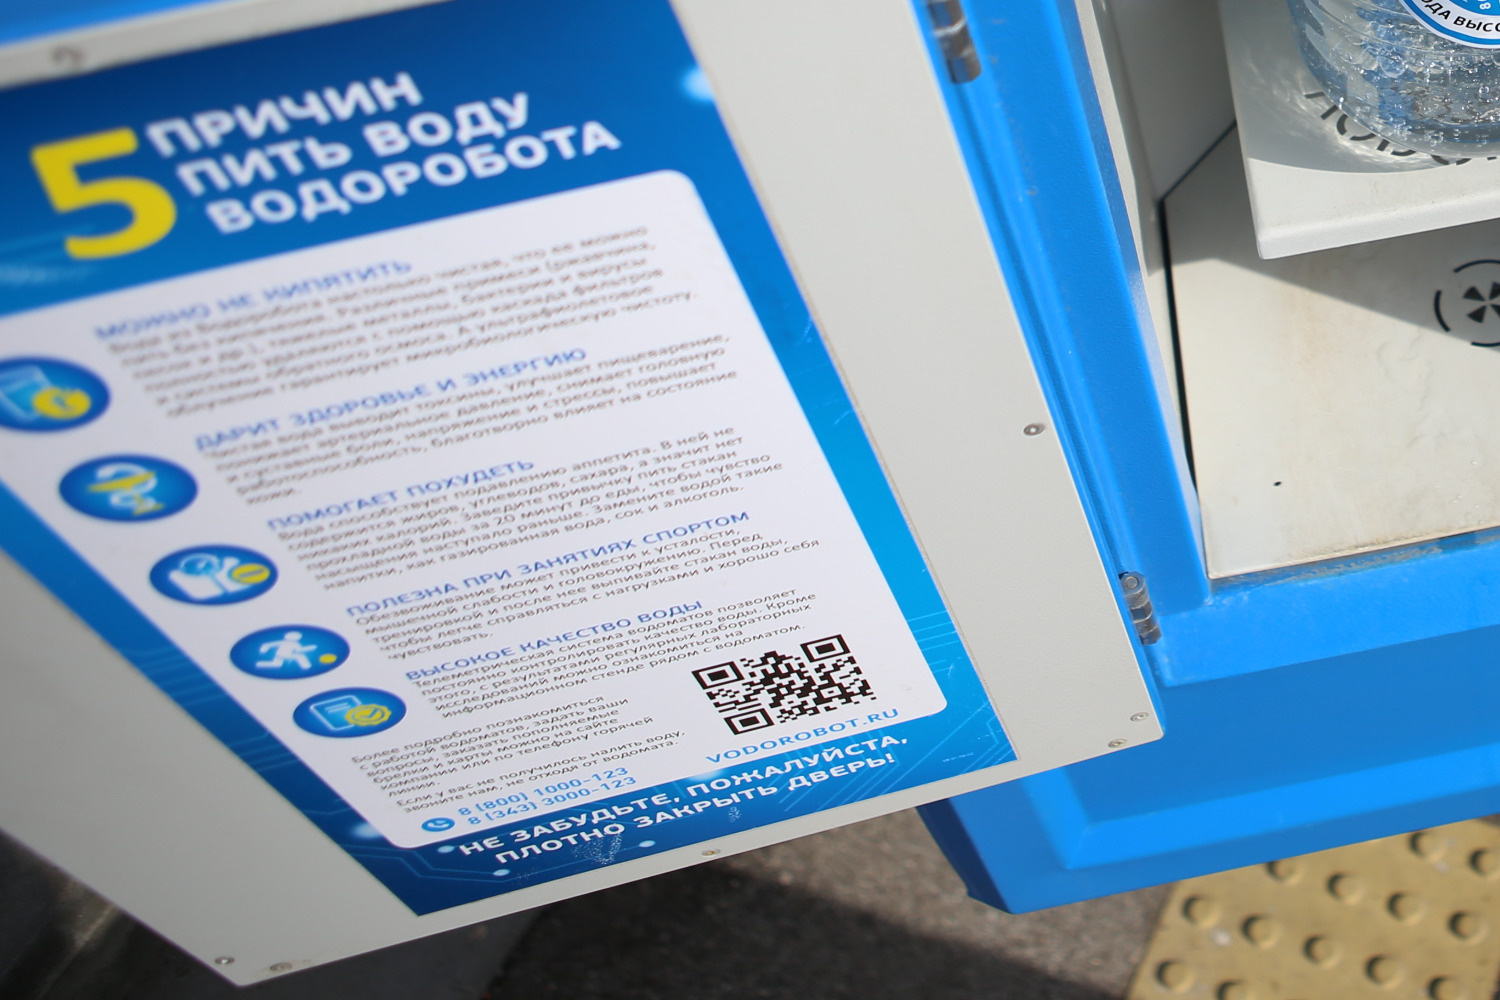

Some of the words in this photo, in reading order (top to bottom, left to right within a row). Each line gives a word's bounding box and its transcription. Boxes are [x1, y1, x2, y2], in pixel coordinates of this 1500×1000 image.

[146, 72, 423, 158] ПРИЧИН
[176, 136, 352, 197] ПИТЬ
[363, 93, 529, 157] ВОДУ
[31, 128, 177, 259] 5
[206, 120, 622, 234] ВОДОРОБОТА
[195, 418, 279, 452] ДАРИТ
[290, 384, 430, 426] ЗДОРОВЬЕ
[464, 348, 586, 386] ЭНЕРГИЮ
[267, 490, 397, 530] ПОМОГАЕТ
[406, 461, 534, 497] ПОХУДЕТЬ
[346, 583, 458, 616] ПОЛЕЗНА
[462, 569, 512, 588] ПРИ
[517, 539, 636, 575] ЗАНЯТИЯХ
[642, 511, 749, 544] СПОРТОМ
[356, 587, 496, 625] Обезвоживание
[500, 572, 553, 591] может
[559, 552, 637, 576] привести
[653, 528, 740, 555] усталости,
[365, 605, 458, 635] мышечной
[462, 587, 539, 611] слабости
[558, 548, 705, 587] головокружению.
[709, 533, 763, 550] Перед
[372, 610, 484, 643] тренировкой
[502, 594, 552, 612] после
[556, 586, 587, 599] нее
[591, 563, 680, 590] выпивайте
[683, 549, 737, 567] стакан
[741, 538, 788, 553] воды,
[379, 632, 433, 651] чтобы
[437, 622, 483, 639] легче
[486, 596, 588, 626] справляться
[605, 569, 699, 597] нагрузками
[717, 549, 779, 570] хорошо
[783, 539, 819, 553] себя
[388, 632, 493, 660] чувствовать.
[405, 647, 515, 680] ВЫСОКОЕ
[519, 618, 631, 652] КАЧЕСТВО
[637, 600, 702, 623] ВОДЫ
[413, 649, 554, 687] Телеметрическая
[558, 632, 623, 653] система
[627, 610, 713, 635] водоматов
[717, 589, 795, 613] позволяет
[421, 670, 507, 696] постоянно
[510, 638, 640, 674] контролировать
[643, 619, 713, 641] качество
[717, 608, 762, 625] воды.
[765, 594, 816, 610] Кроме
[428, 688, 476, 704] этого,
[491, 656, 600, 689] результатами
[604, 632, 697, 661] регулярных
[700, 604, 811, 636] лабораторных
[435, 677, 549, 711] исследований
[553, 663, 608, 682] можно
[612, 635, 720, 666] ознакомиться
[724, 630, 743, 639] на
[442, 678, 587, 718] информационном
[591, 663, 645, 681] стенде
[648, 650, 699, 668] рядом
[715, 624, 805, 650] водоматом.
[351, 747, 400, 764] Более
[403, 727, 482, 750] подробно
[486, 696, 604, 729] познакомиться
[366, 756, 439, 777] вопросы,
[442, 738, 509, 758] заказать
[512, 709, 619, 740] пополняемые
[371, 746, 436, 769] работой
[440, 725, 529, 750] водоматов,
[532, 710, 584, 727] задать
[588, 698, 629, 713] ваши
[372, 765, 430, 784] брелки
[446, 749, 493, 766] карты
[496, 735, 550, 753] можно
[553, 729, 573, 738] на
[576, 718, 618, 733] сайте
[380, 767, 458, 790] компании
[461, 758, 491, 770] или
[493, 752, 513, 762] по
[516, 733, 588, 755] телефону
[593, 716, 653, 736] горячей
[396, 793, 433, 807] Если
[447, 783, 474, 794] вас
[476, 778, 496, 787] не
[499, 755, 587, 781] получилось
[590, 741, 642, 757] налить
[645, 730, 685, 743] воду,
[706, 708, 898, 763] VODOROBOT.RU
[388, 780, 440, 798] линии.
[403, 794, 464, 813] звоните
[467, 785, 503, 797] нам,
[505, 778, 525, 787] не
[528, 764, 579, 781] отходя
[582, 759, 598, 767] от
[602, 740, 678, 762] водомата.
[459, 837, 504, 857] НЕ
[510, 794, 679, 843] ЗАБУДЬТЕ,
[686, 734, 907, 797] ПОЖАЛУЙСТА,
[475, 792, 528, 812] (800)
[533, 767, 628, 796] 1000-123
[484, 801, 538, 821] (343)
[541, 776, 636, 806] 3000-123
[494, 824, 625, 865] ПЛОТНО
[632, 783, 778, 829] ЗАКРЫТЬ
[787, 752, 896, 791] ДВЕРЬ!
